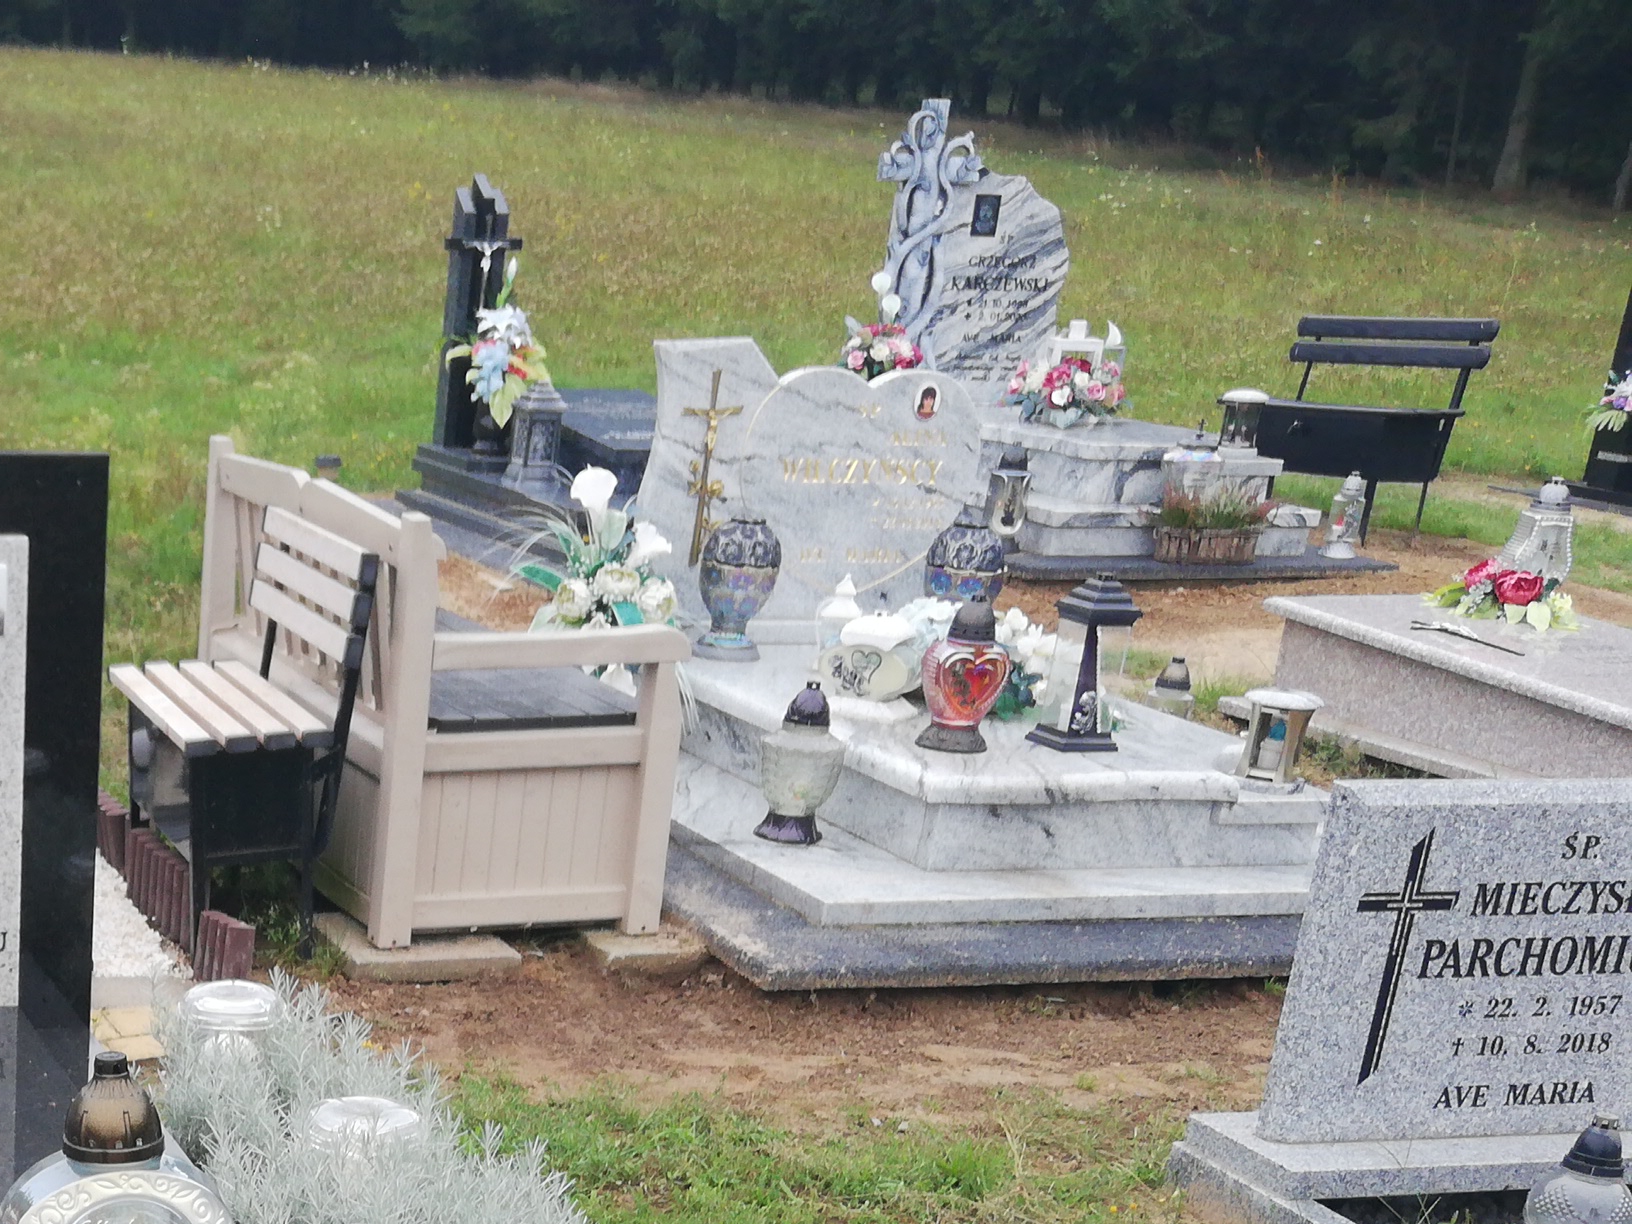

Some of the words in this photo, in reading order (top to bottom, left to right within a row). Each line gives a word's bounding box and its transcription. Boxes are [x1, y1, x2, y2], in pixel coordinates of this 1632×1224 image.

[950, 275, 1050, 292] KARCZEWSKI
[1417, 935, 1632, 979] PARCHOMI
[1484, 998, 1518, 1018] 22.
[1532, 997, 1551, 1017] 2.
[1568, 994, 1623, 1017] 1957
[1476, 1036, 1508, 1056] 10.
[1523, 1034, 1542, 1054] 8.
[1556, 1032, 1612, 1054] 2018
[1432, 1085, 1489, 1109] AVE
[1503, 1081, 1595, 1106] MARIA
